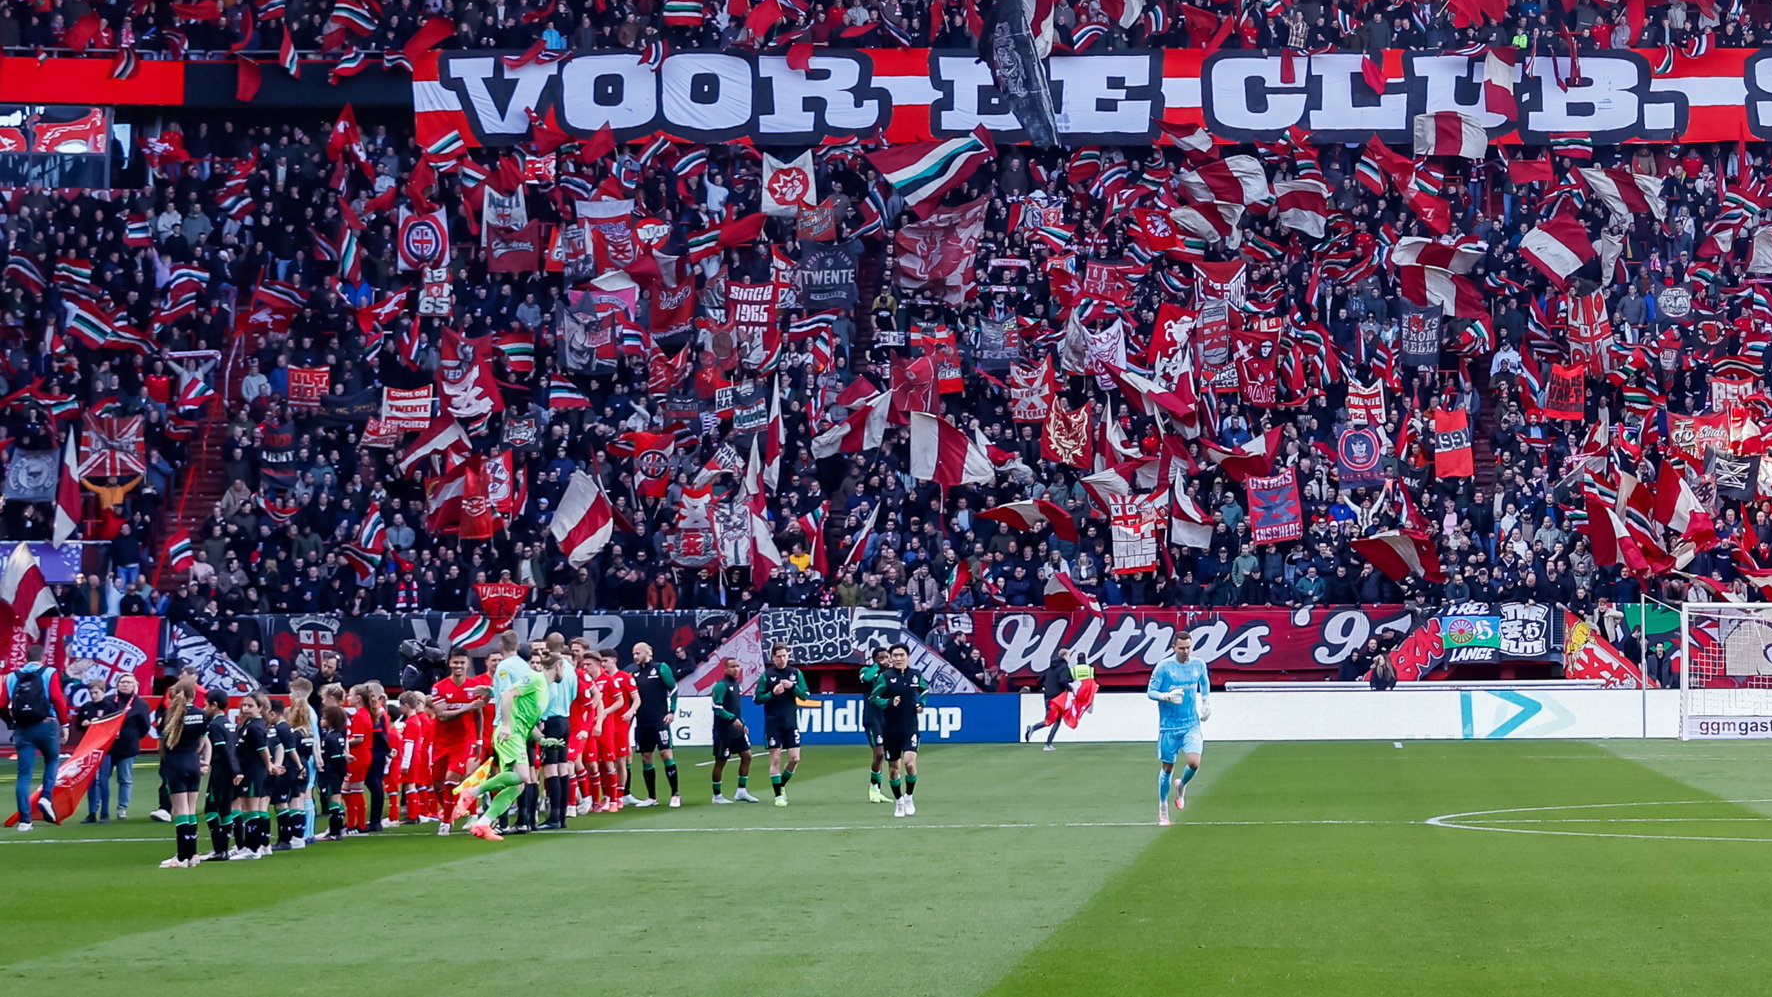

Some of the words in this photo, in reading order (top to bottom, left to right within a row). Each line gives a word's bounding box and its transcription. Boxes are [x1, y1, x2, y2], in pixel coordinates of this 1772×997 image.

[448, 52, 888, 134] VOOR
[940, 54, 1152, 132] DE
[802, 269, 855, 285] TWENTE
[730, 285, 773, 303] SINCE
[419, 297, 450, 315] 65
[734, 304, 769, 323] 1965
[1402, 314, 1438, 330] BYS
[1402, 328, 1436, 342] FROM
[1402, 340, 1438, 353] HELL!
[1712, 382, 1752, 400] RED
[388, 403, 430, 414] TWENTE
[262, 450, 295, 463] ARMY
[1249, 474, 1292, 491] ULTRAS
[1252, 522, 1302, 542] ENSCHEDE
[1447, 602, 1490, 616] FREE
[1501, 604, 1546, 621] THE
[996, 613, 1270, 673] Ultras
[1449, 647, 1496, 662] LANGE
[679, 708, 693, 718] bv
[797, 705, 963, 739] ildmp
[658, 730, 669, 741] 18
[676, 726, 692, 741] G
